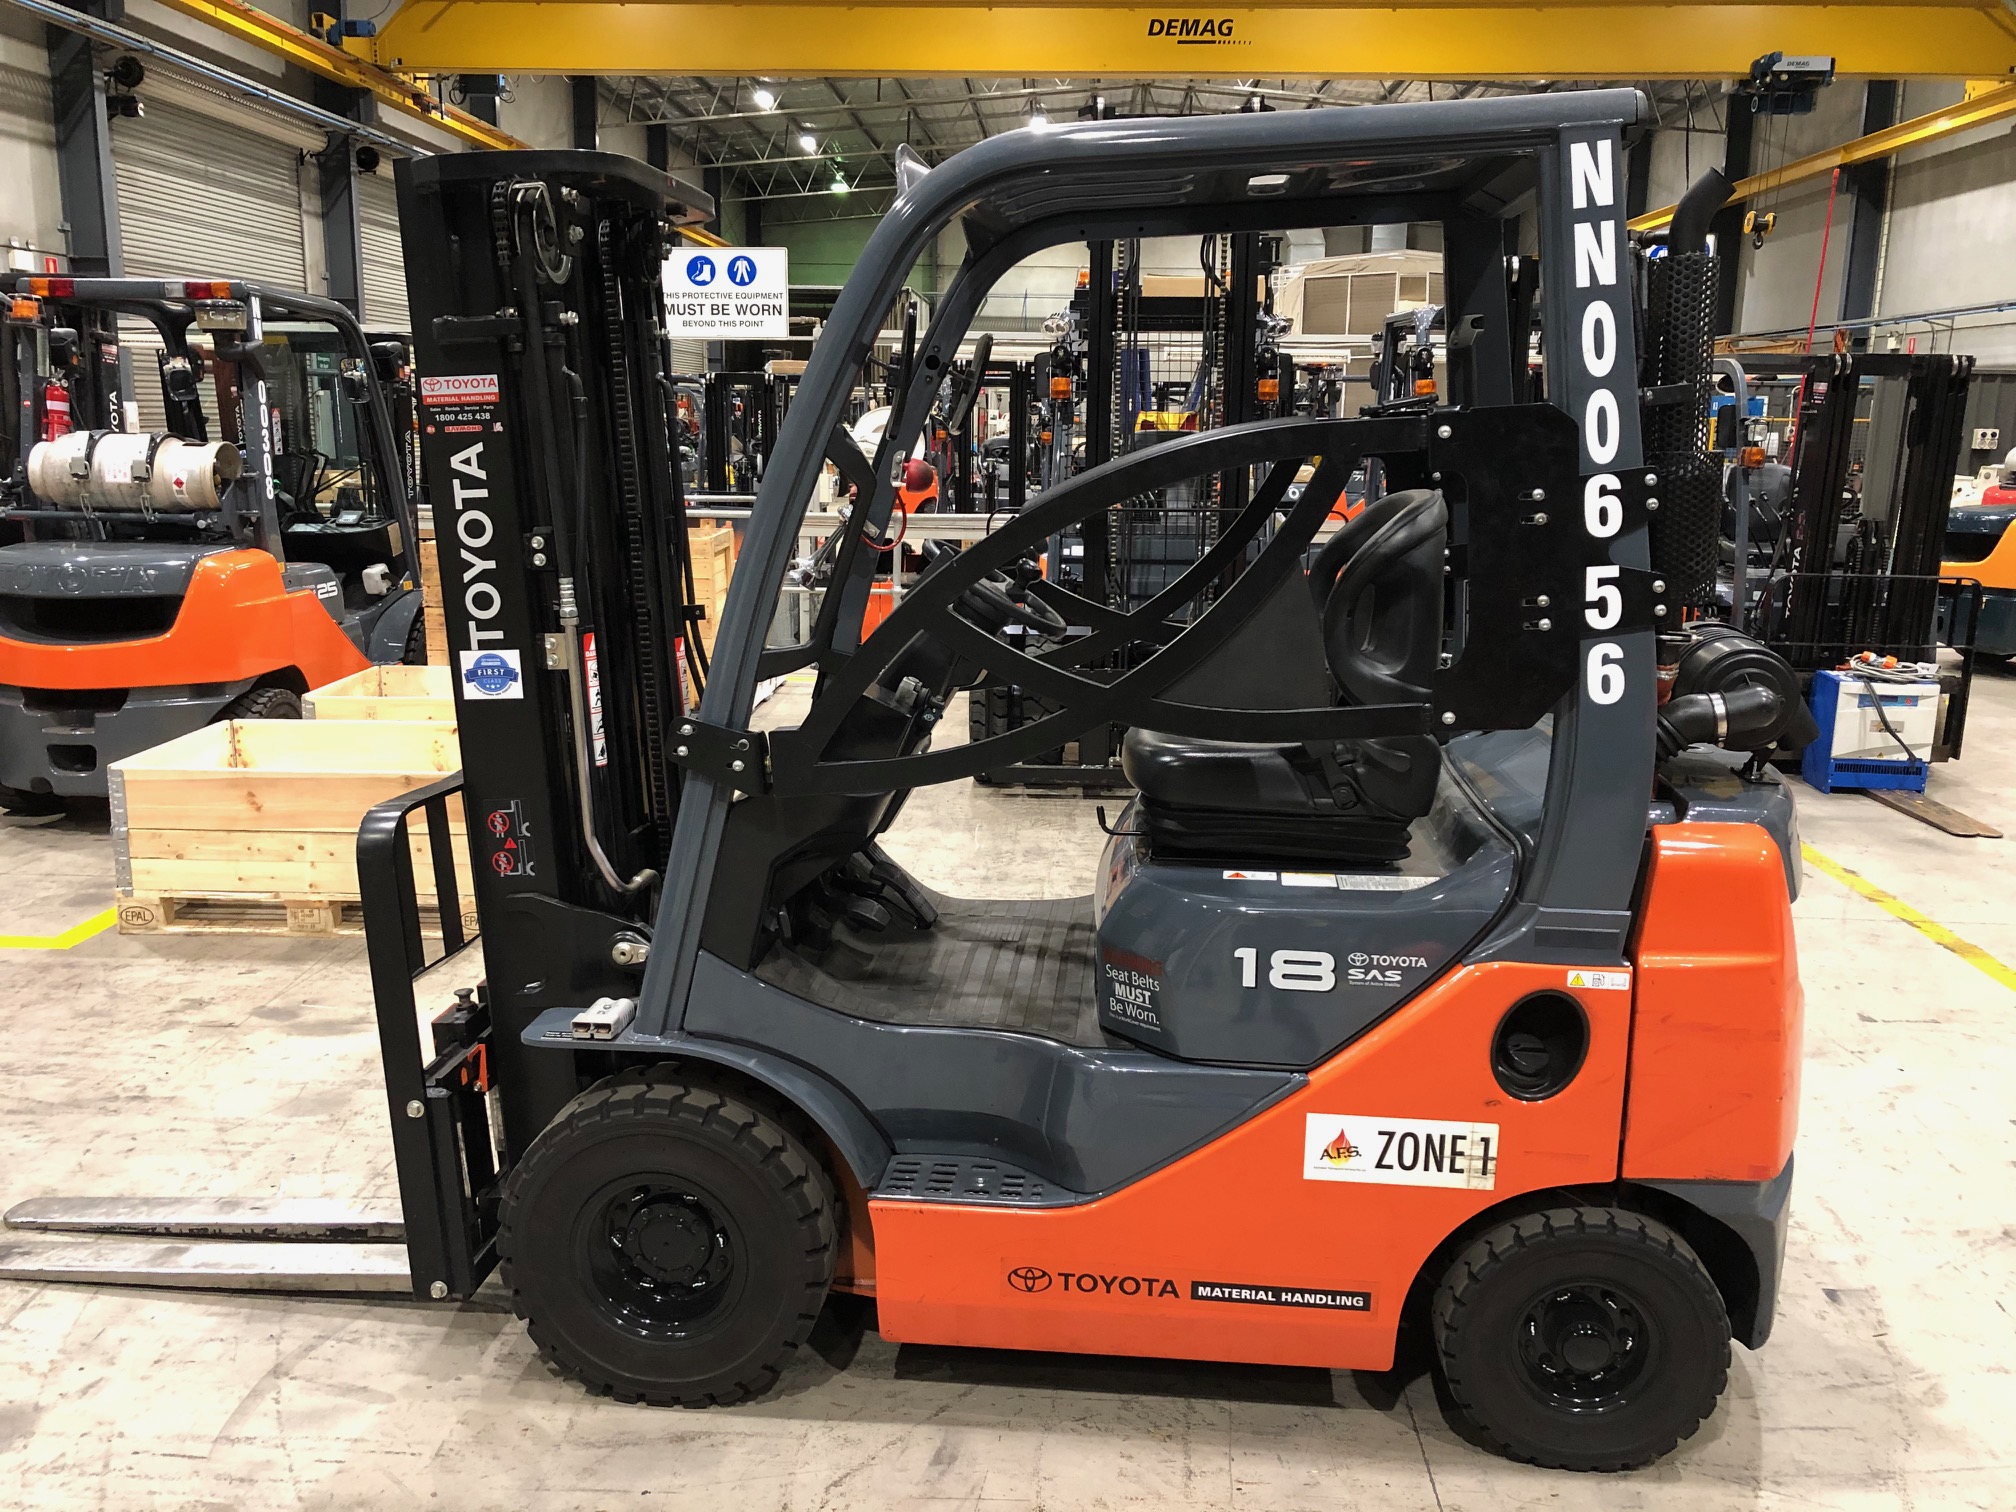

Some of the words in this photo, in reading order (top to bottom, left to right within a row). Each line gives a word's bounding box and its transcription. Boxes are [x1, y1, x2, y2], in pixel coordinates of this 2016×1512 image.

[1147, 19, 1234, 36] DEMAG
[682, 292, 733, 300] PROTECTIVE
[735, 292, 784, 300] EQUIPMENT
[664, 303, 706, 316] MUST
[710, 303, 731, 316] BE
[735, 303, 783, 316] WORN
[682, 320, 717, 328] BEYOND
[719, 320, 738, 328] THIS
[739, 320, 765, 328] POINT
[443, 377, 497, 390] TOYOTA
[426, 395, 460, 403] MATERIAL
[435, 413, 456, 422] 1800
[457, 413, 473, 421] 425
[474, 412, 491, 420] 438
[1570, 139, 1626, 705] NN00656
[404, 430, 414, 499] TOYOTA
[450, 441, 505, 650] TOYOTA
[316, 580, 339, 600] 25
[477, 668, 505, 676] FIRST
[125, 910, 149, 922] EPAL
[1234, 946, 1336, 992] 18
[1370, 954, 1428, 968] TOYOTA
[1105, 963, 1130, 983] Seat
[1132, 971, 1160, 991] Belts
[1347, 968, 1402, 982] SAS
[1114, 982, 1152, 1005] MUST
[1109, 997, 1124, 1014] Be
[1125, 1001, 1160, 1024] Worn.
[1319, 1145, 1362, 1161] A.F.S.
[1375, 1130, 1468, 1174] ZONE
[1480, 1136, 1491, 1176] 1
[1057, 1271, 1181, 1299] TOYOTA
[1197, 1285, 1277, 1302] MATERIAL
[1280, 1291, 1365, 1308] HANDLING
